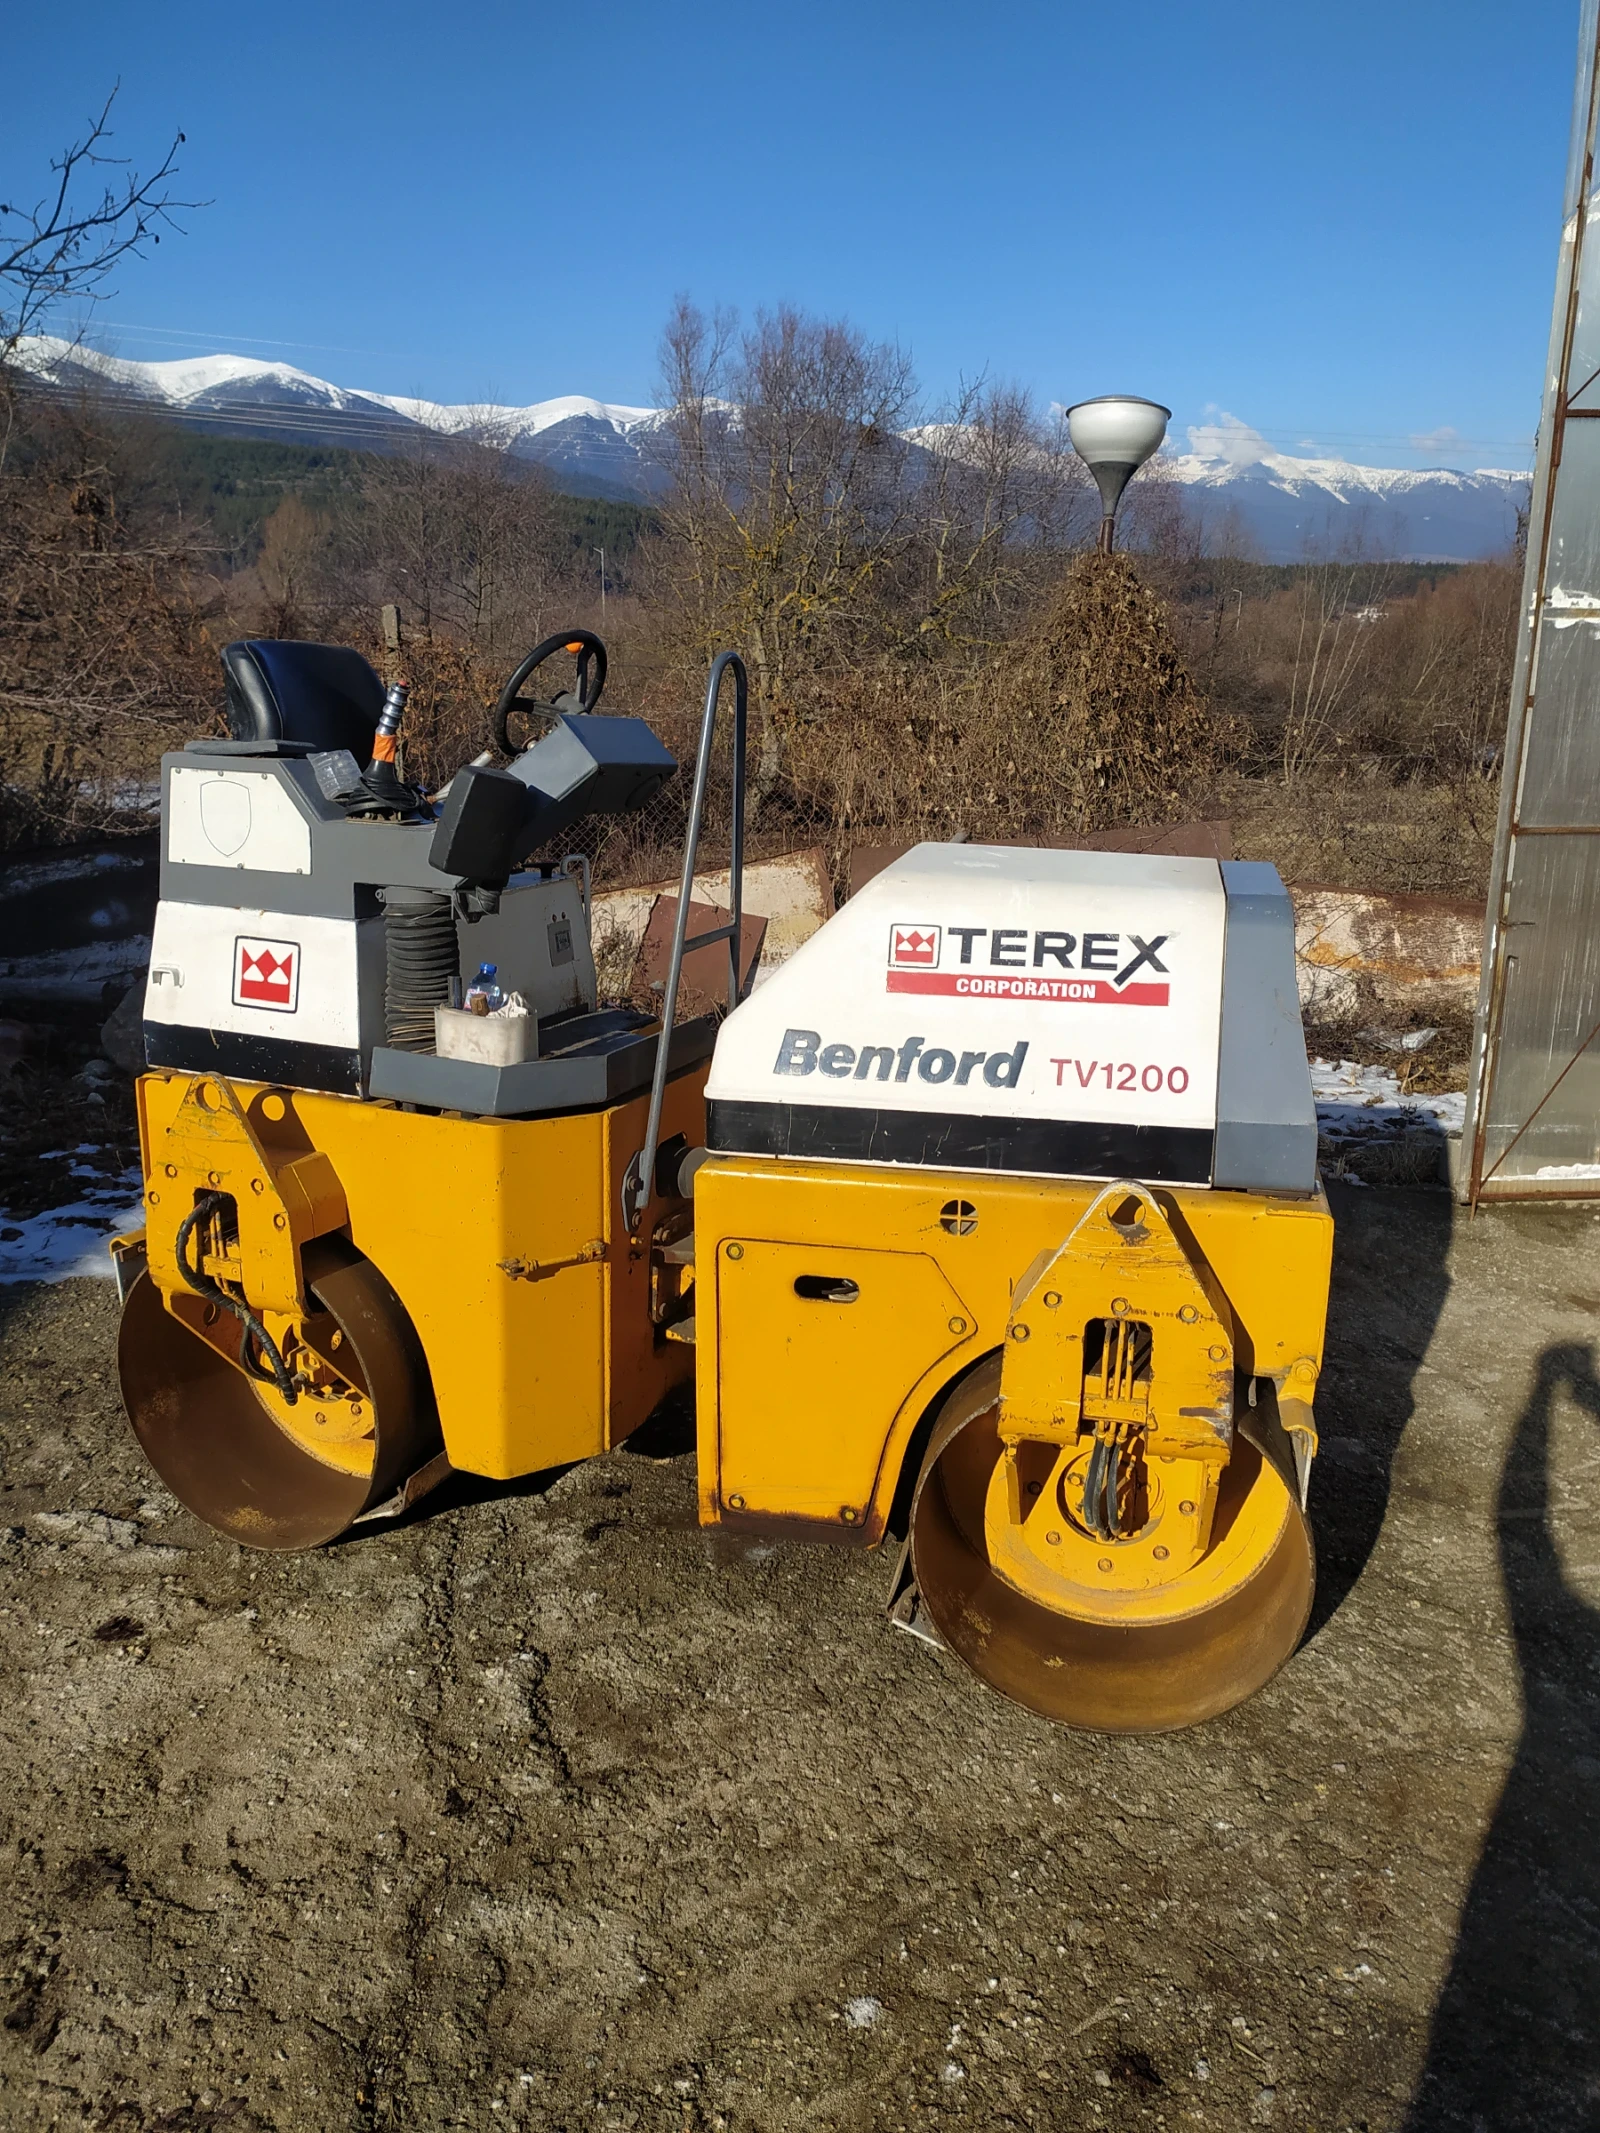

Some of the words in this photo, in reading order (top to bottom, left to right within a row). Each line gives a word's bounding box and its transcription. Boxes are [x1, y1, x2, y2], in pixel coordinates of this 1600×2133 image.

[948, 927, 1170, 987] TEREX
[956, 978, 1096, 999] CORPORATION
[773, 1028, 1029, 1089] Benford
[1050, 1058, 1189, 1094] TV1200
